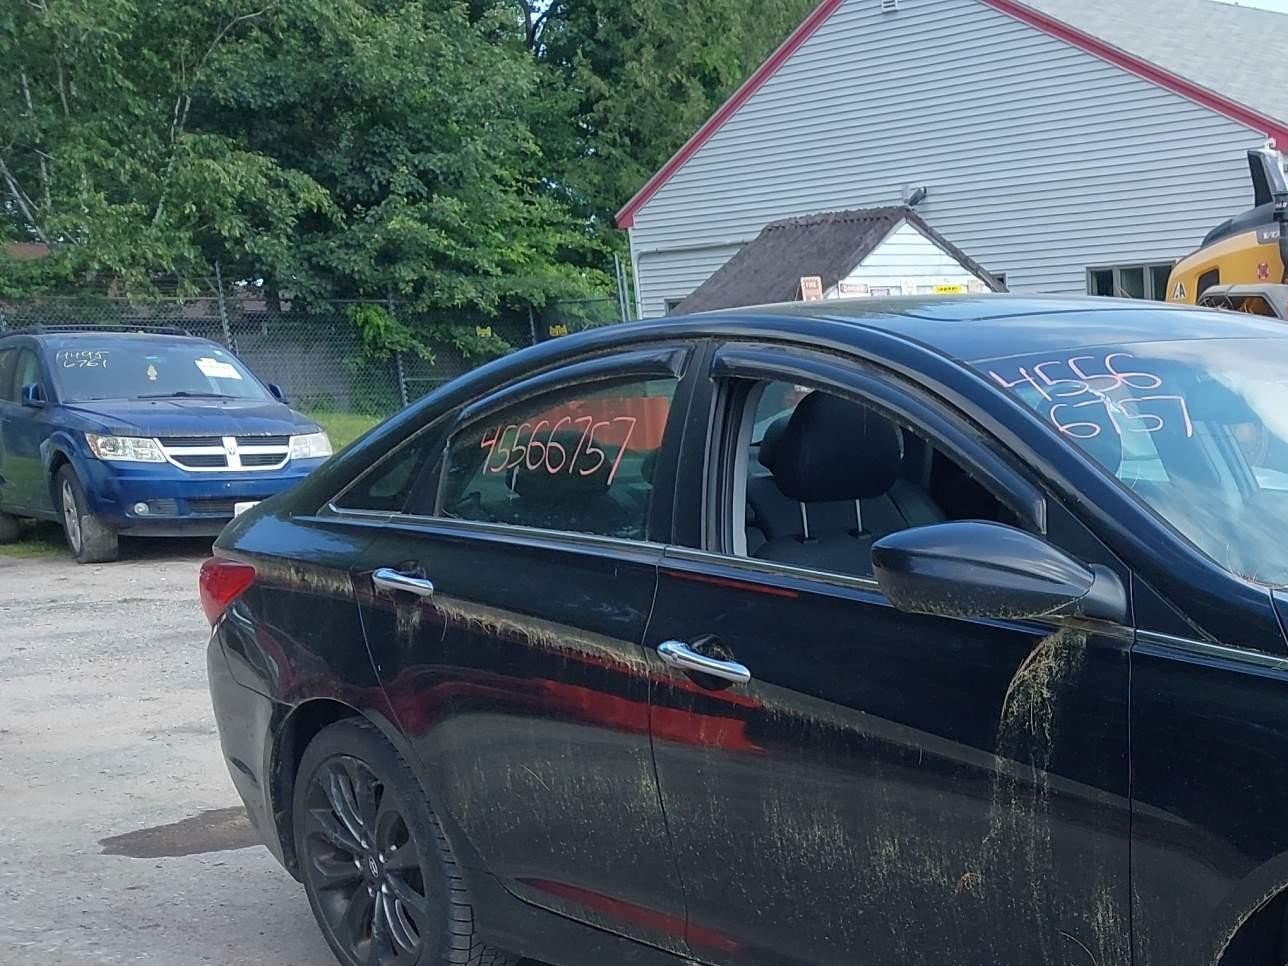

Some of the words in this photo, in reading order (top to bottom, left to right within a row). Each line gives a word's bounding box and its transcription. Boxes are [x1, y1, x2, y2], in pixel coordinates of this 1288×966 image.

[988, 352, 1163, 402] 4556
[1050, 395, 1194, 439] 6757
[480, 415, 637, 487] 45566757
